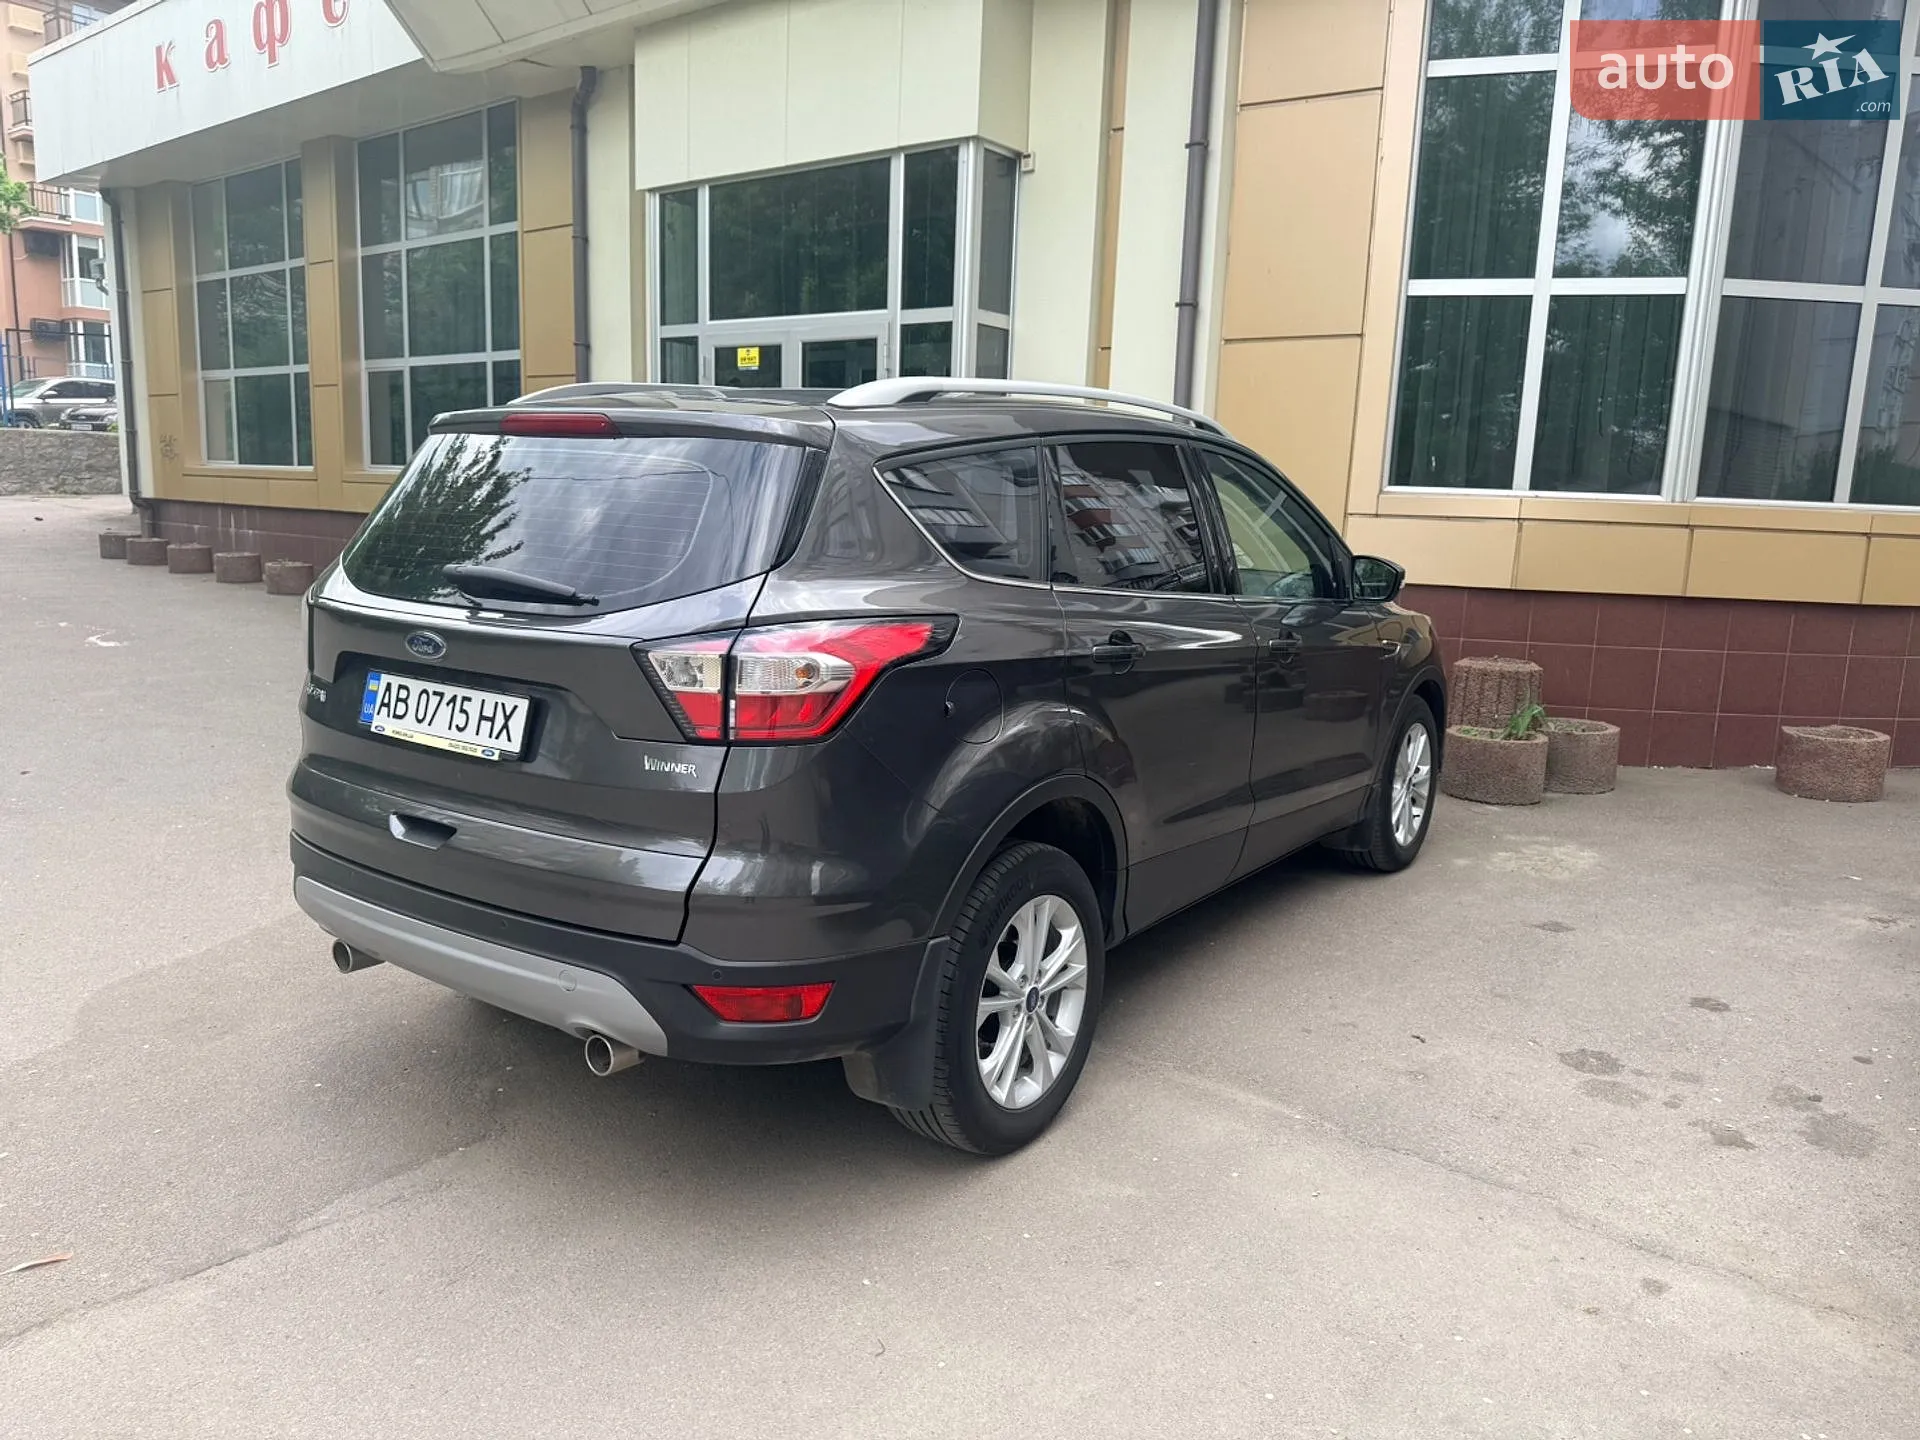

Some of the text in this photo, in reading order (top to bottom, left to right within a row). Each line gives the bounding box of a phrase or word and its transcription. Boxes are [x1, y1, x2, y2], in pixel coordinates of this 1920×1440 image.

[377, 681, 411, 720] AB
[414, 688, 473, 733] 0715
[475, 698, 518, 743] HX
